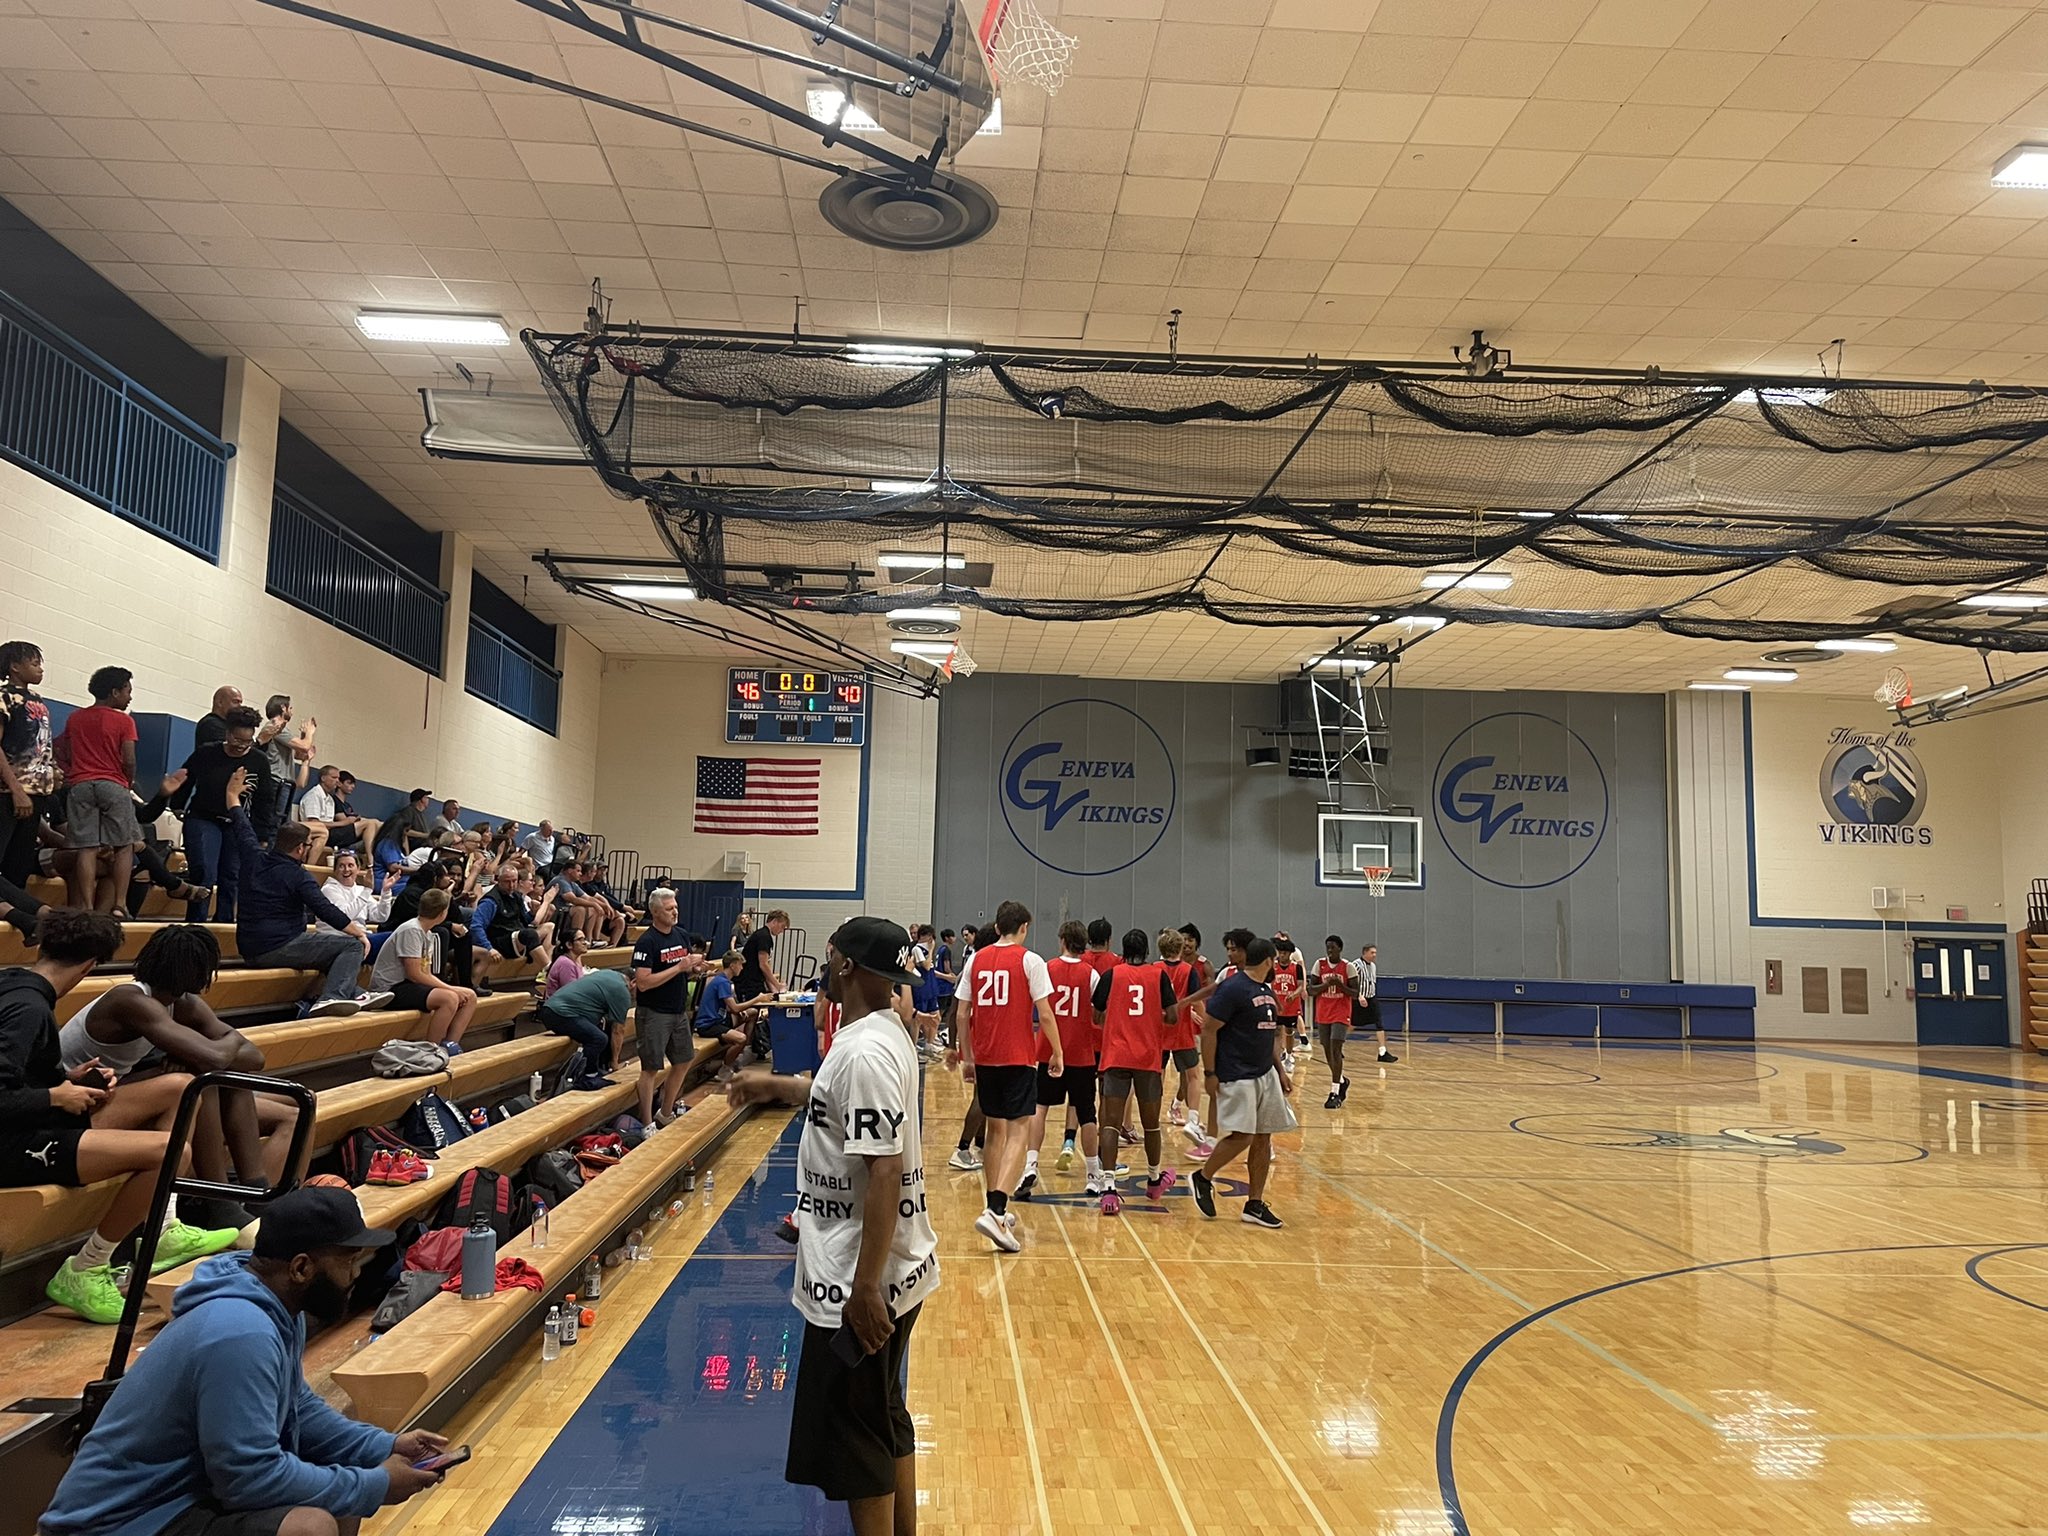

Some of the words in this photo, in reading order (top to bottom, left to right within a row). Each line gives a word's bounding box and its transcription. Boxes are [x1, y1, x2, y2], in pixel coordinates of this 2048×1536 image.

[734, 671, 759, 680] HOME
[780, 673, 815, 691] 0.0
[832, 674, 864, 683] VISITOR
[736, 682, 760, 700] 46
[838, 685, 861, 703] 40
[1827, 727, 1872, 747] Home
[1875, 731, 1892, 748] of
[1892, 731, 1917, 748] the
[1819, 824, 1932, 845] VIKINGS
[977, 969, 1010, 1006] 20
[1054, 984, 1080, 1018] 21
[1128, 984, 1144, 1016] 3
[797, 1190, 854, 1219] ERRY
